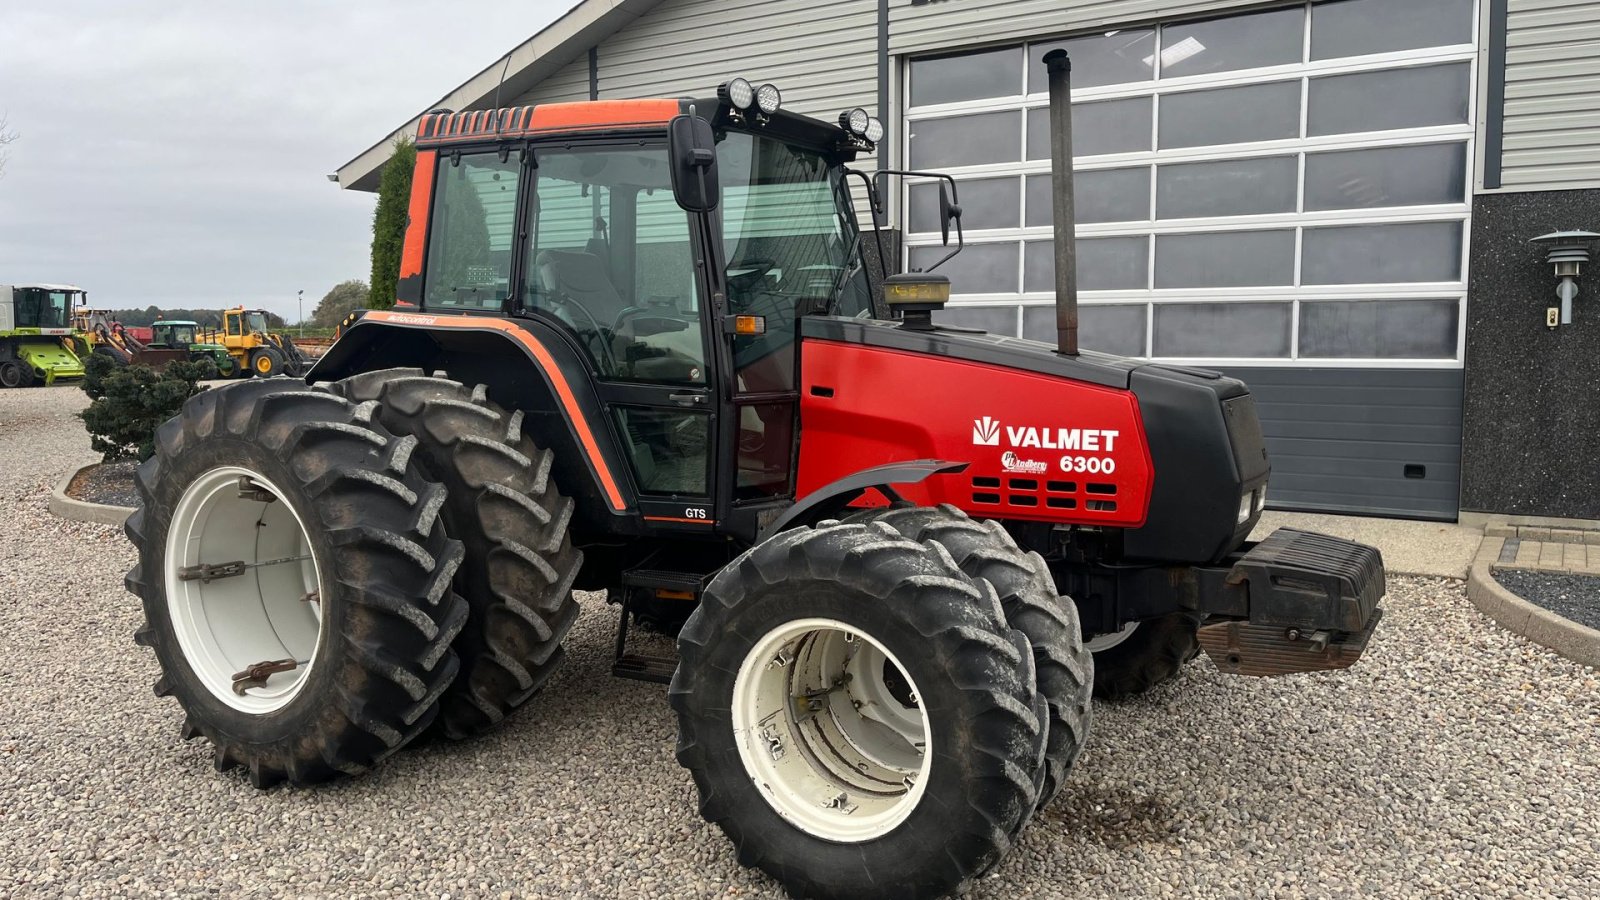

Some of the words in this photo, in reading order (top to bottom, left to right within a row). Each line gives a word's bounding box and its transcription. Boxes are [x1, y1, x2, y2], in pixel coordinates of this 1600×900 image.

[1006, 426, 1119, 452] VALMET
[1060, 455, 1116, 475] 6300
[685, 508, 706, 519] GTS
